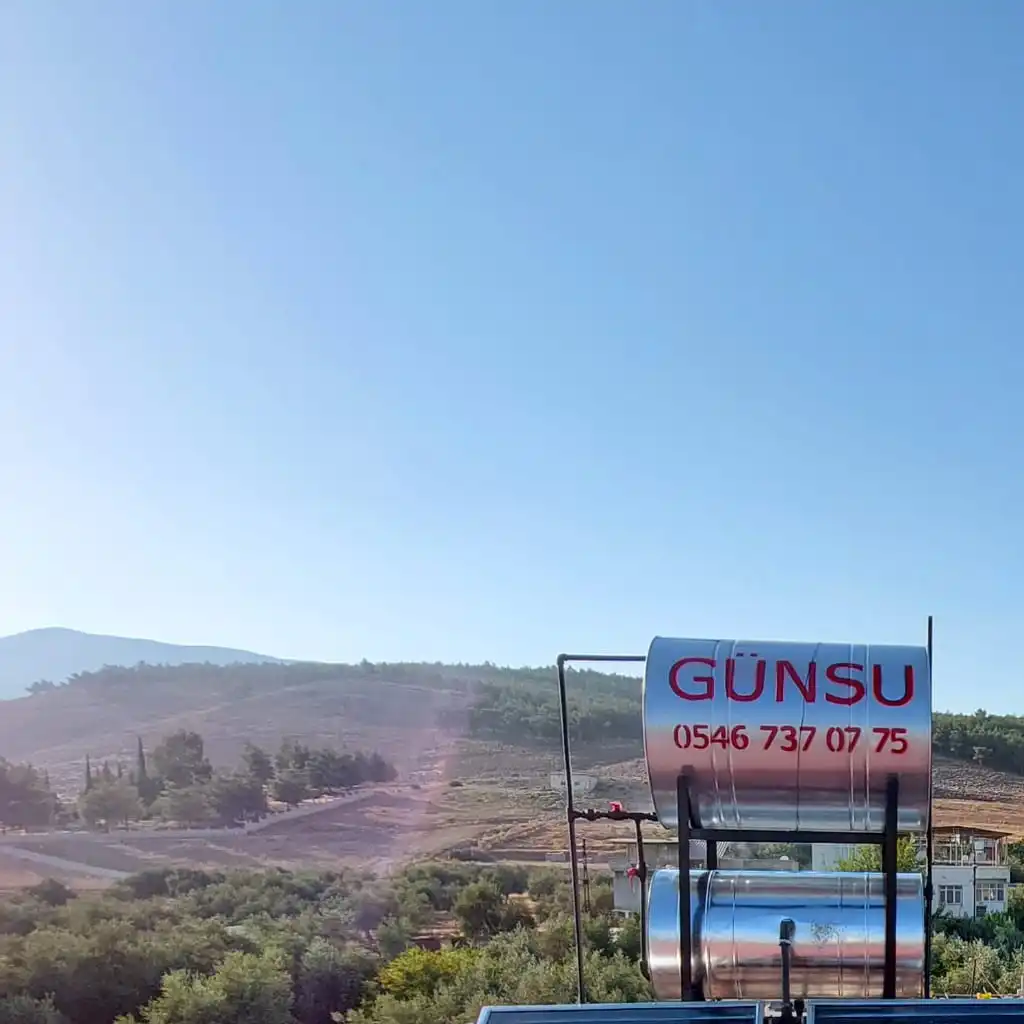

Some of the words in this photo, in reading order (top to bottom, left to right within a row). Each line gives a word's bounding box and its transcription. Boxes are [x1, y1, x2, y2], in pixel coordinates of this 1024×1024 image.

[668, 652, 914, 707] GÜNSU
[673, 724, 749, 750] 0546
[759, 725, 816, 752] 737
[825, 727, 861, 752] 07
[872, 727, 909, 753] 75
